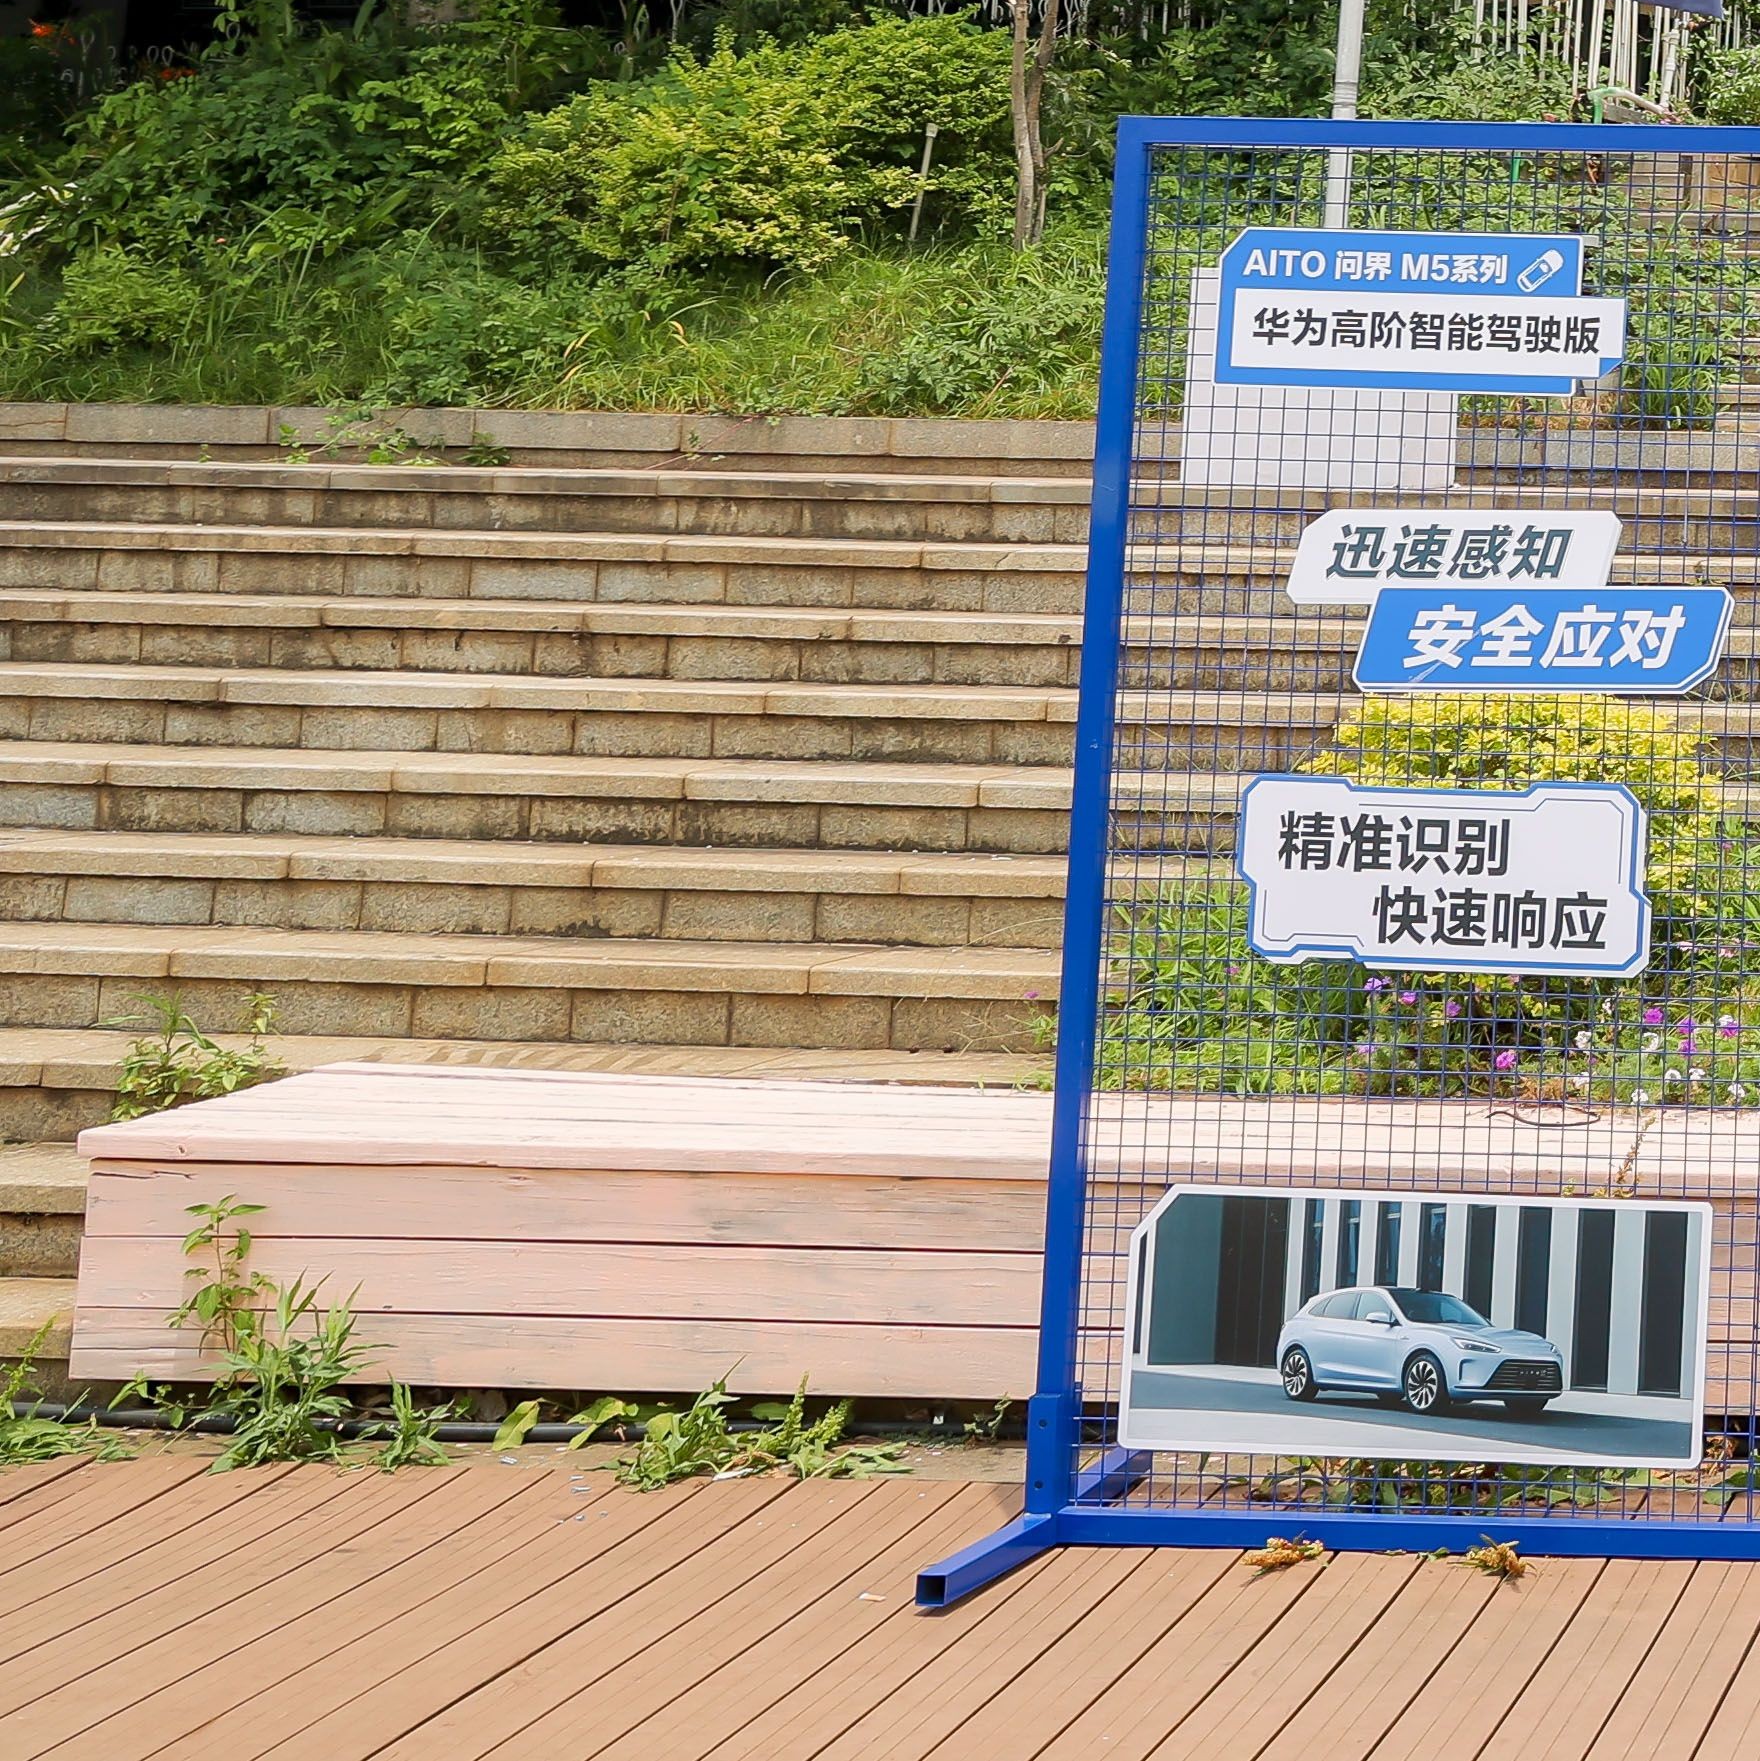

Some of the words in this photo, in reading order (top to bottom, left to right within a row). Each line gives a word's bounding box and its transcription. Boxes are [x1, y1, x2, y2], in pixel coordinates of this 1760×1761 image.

[1243, 249, 1326, 279] AITO
[1334, 251, 1392, 280] 问界
[1402, 253, 1508, 285] M5系列
[1252, 307, 1601, 356] 华为高阶智能驾驶版
[1326, 523, 1575, 581] 迅速感知
[1402, 603, 1687, 670] 安全应对
[1278, 809, 1511, 878] 精准识别
[1372, 884, 1609, 951] 快速响应
